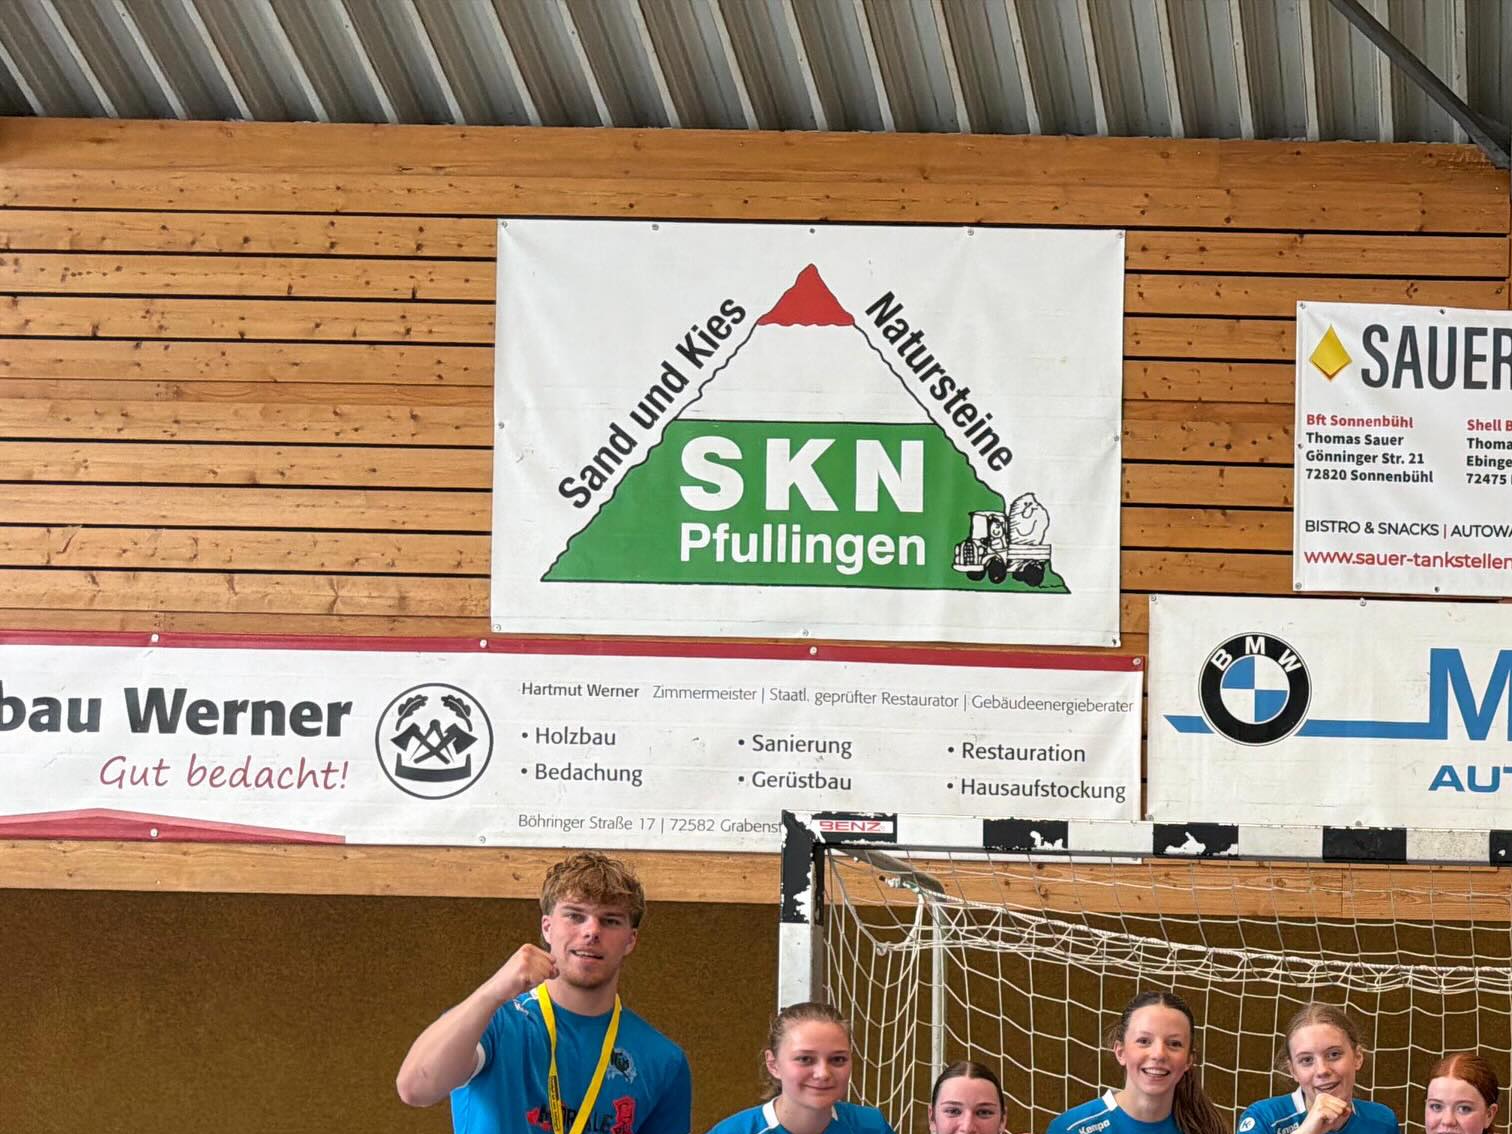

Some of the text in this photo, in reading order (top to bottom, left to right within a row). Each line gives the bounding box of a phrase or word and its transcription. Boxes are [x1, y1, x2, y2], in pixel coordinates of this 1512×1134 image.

[865, 291, 1014, 472] Natursteine
[558, 298, 747, 509] Sand und Kies
[1306, 413, 1414, 429] Bft Sonnenbühl
[1467, 418, 1502, 432] Shell
[1305, 431, 1405, 446] Thomas Sauer
[1305, 449, 1425, 465] Gönninger Str. 21
[680, 435, 925, 513] SKN
[1305, 468, 1434, 483] 72820 Sonnenbühl
[1466, 472, 1507, 485] 72475
[1305, 519, 1361, 534] BISTRO
[1363, 521, 1375, 534] &
[1377, 522, 1440, 537] SNACKS
[680, 522, 925, 575] Pfullingen
[1210, 636, 1302, 673] BMW
[0, 680, 353, 737] bau Werner
[522, 682, 1134, 715] Hartmut Werner Zimmermeister Staatl. geprüfter Restaurator Gebäudeenergieberater
[535, 727, 616, 746] Holzbau
[752, 735, 852, 758] Sanierung
[962, 743, 1085, 762] Restauration
[99, 754, 349, 790] Gut bedacht!
[535, 763, 643, 787] Bedachung
[752, 771, 851, 790] Gerüstbau
[961, 778, 1125, 803] Hausaufstockung
[519, 814, 585, 832] Böhringer
[589, 816, 632, 831] Straße
[639, 817, 655, 831] 17
[670, 818, 715, 833] 72582
